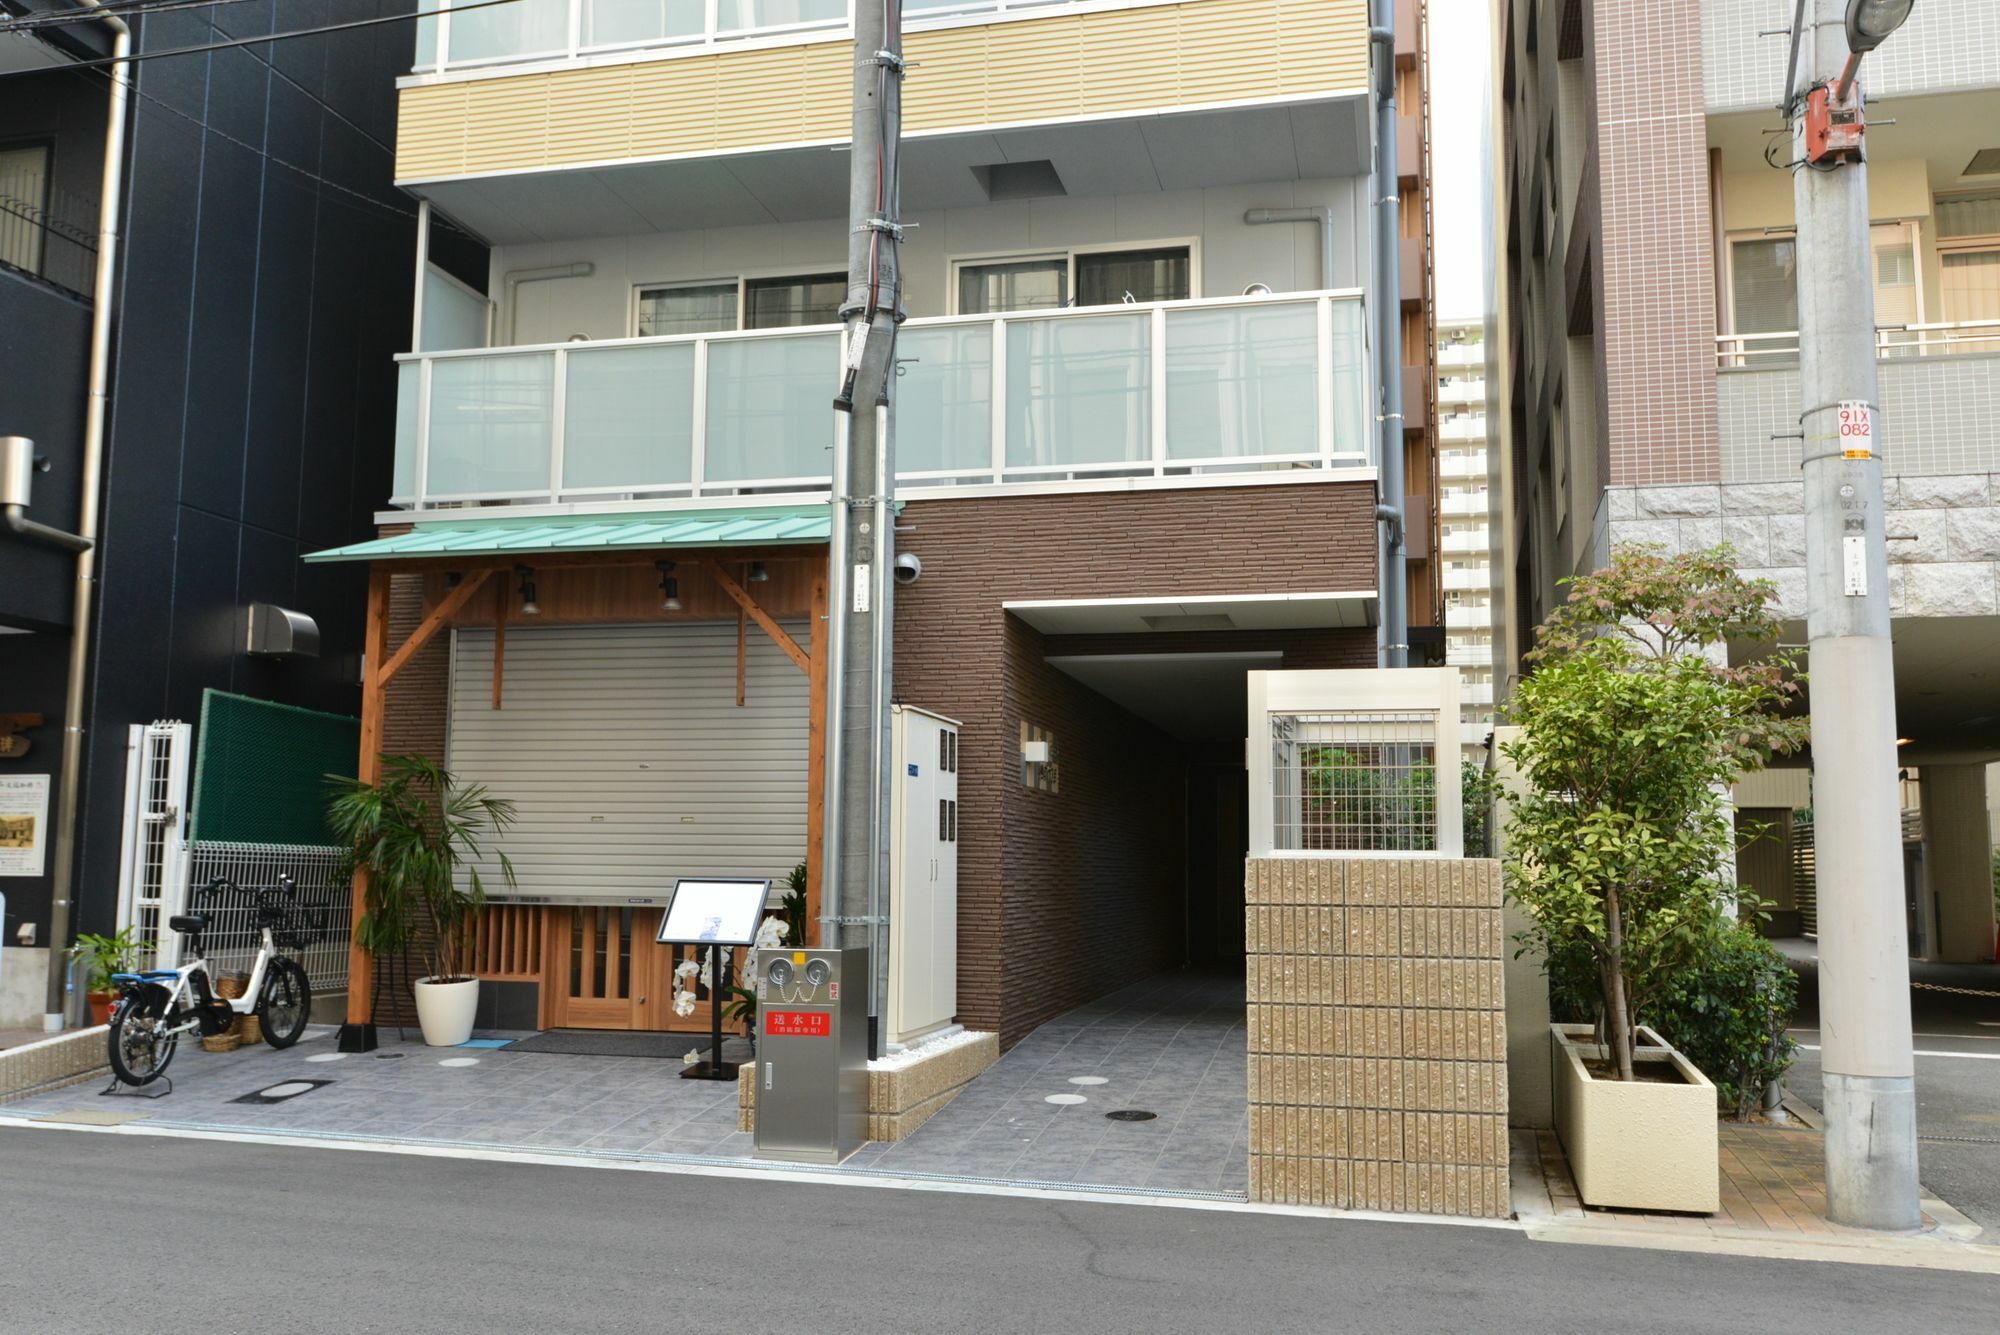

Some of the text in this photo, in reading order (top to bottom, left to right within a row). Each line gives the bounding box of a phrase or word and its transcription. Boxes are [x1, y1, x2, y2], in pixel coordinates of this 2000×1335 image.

[1840, 423, 1870, 437] 082
[774, 1014, 822, 1025] 送水口
